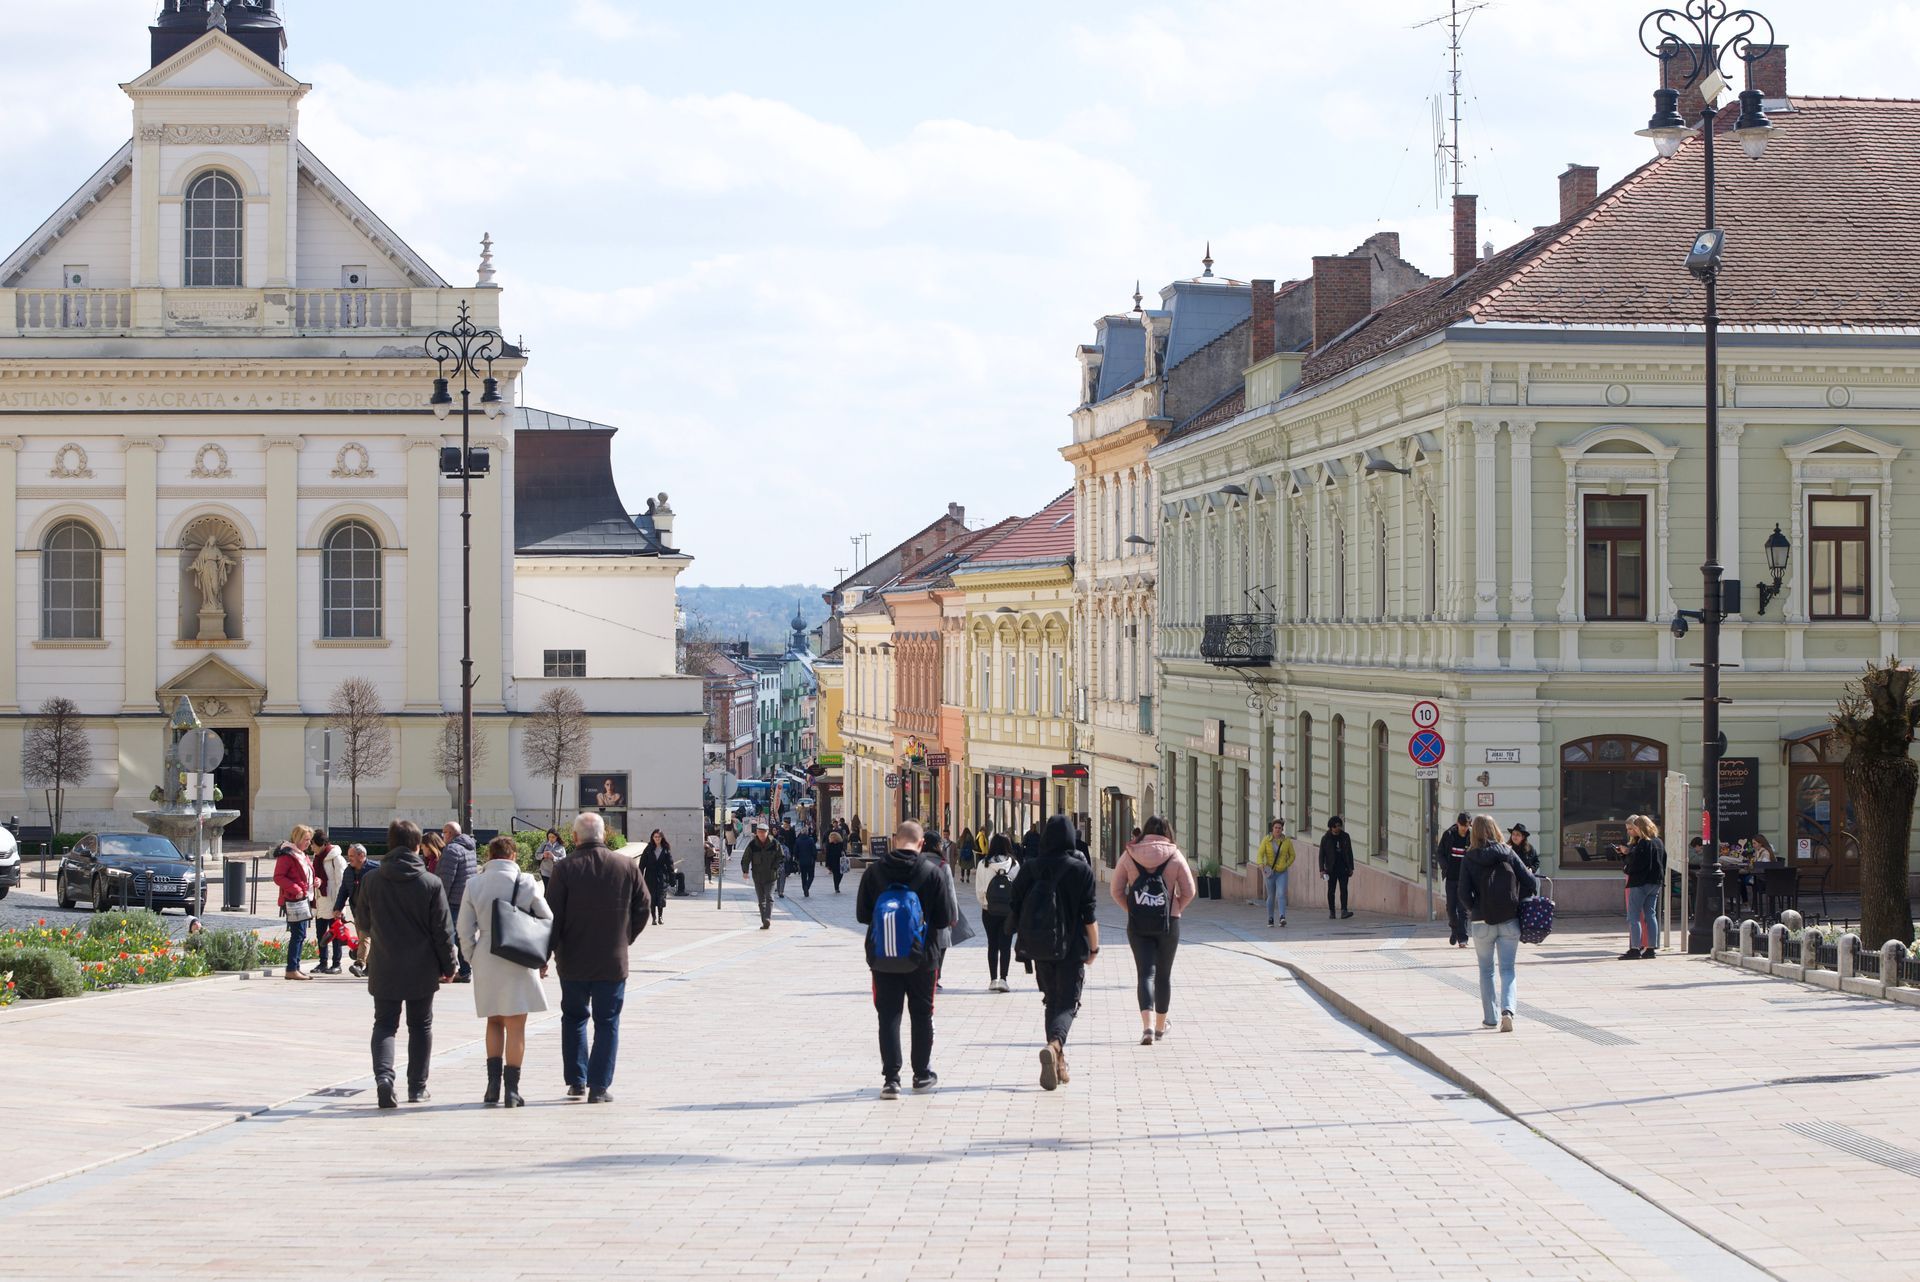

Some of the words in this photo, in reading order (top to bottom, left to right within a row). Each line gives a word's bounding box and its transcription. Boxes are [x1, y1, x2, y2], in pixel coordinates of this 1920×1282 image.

[136, 391, 227, 407] SACRATA
[247, 392, 260, 407] A
[1419, 709, 1432, 721] 10
[1719, 768, 1749, 777] anycipó
[1134, 890, 1166, 907] VANS
